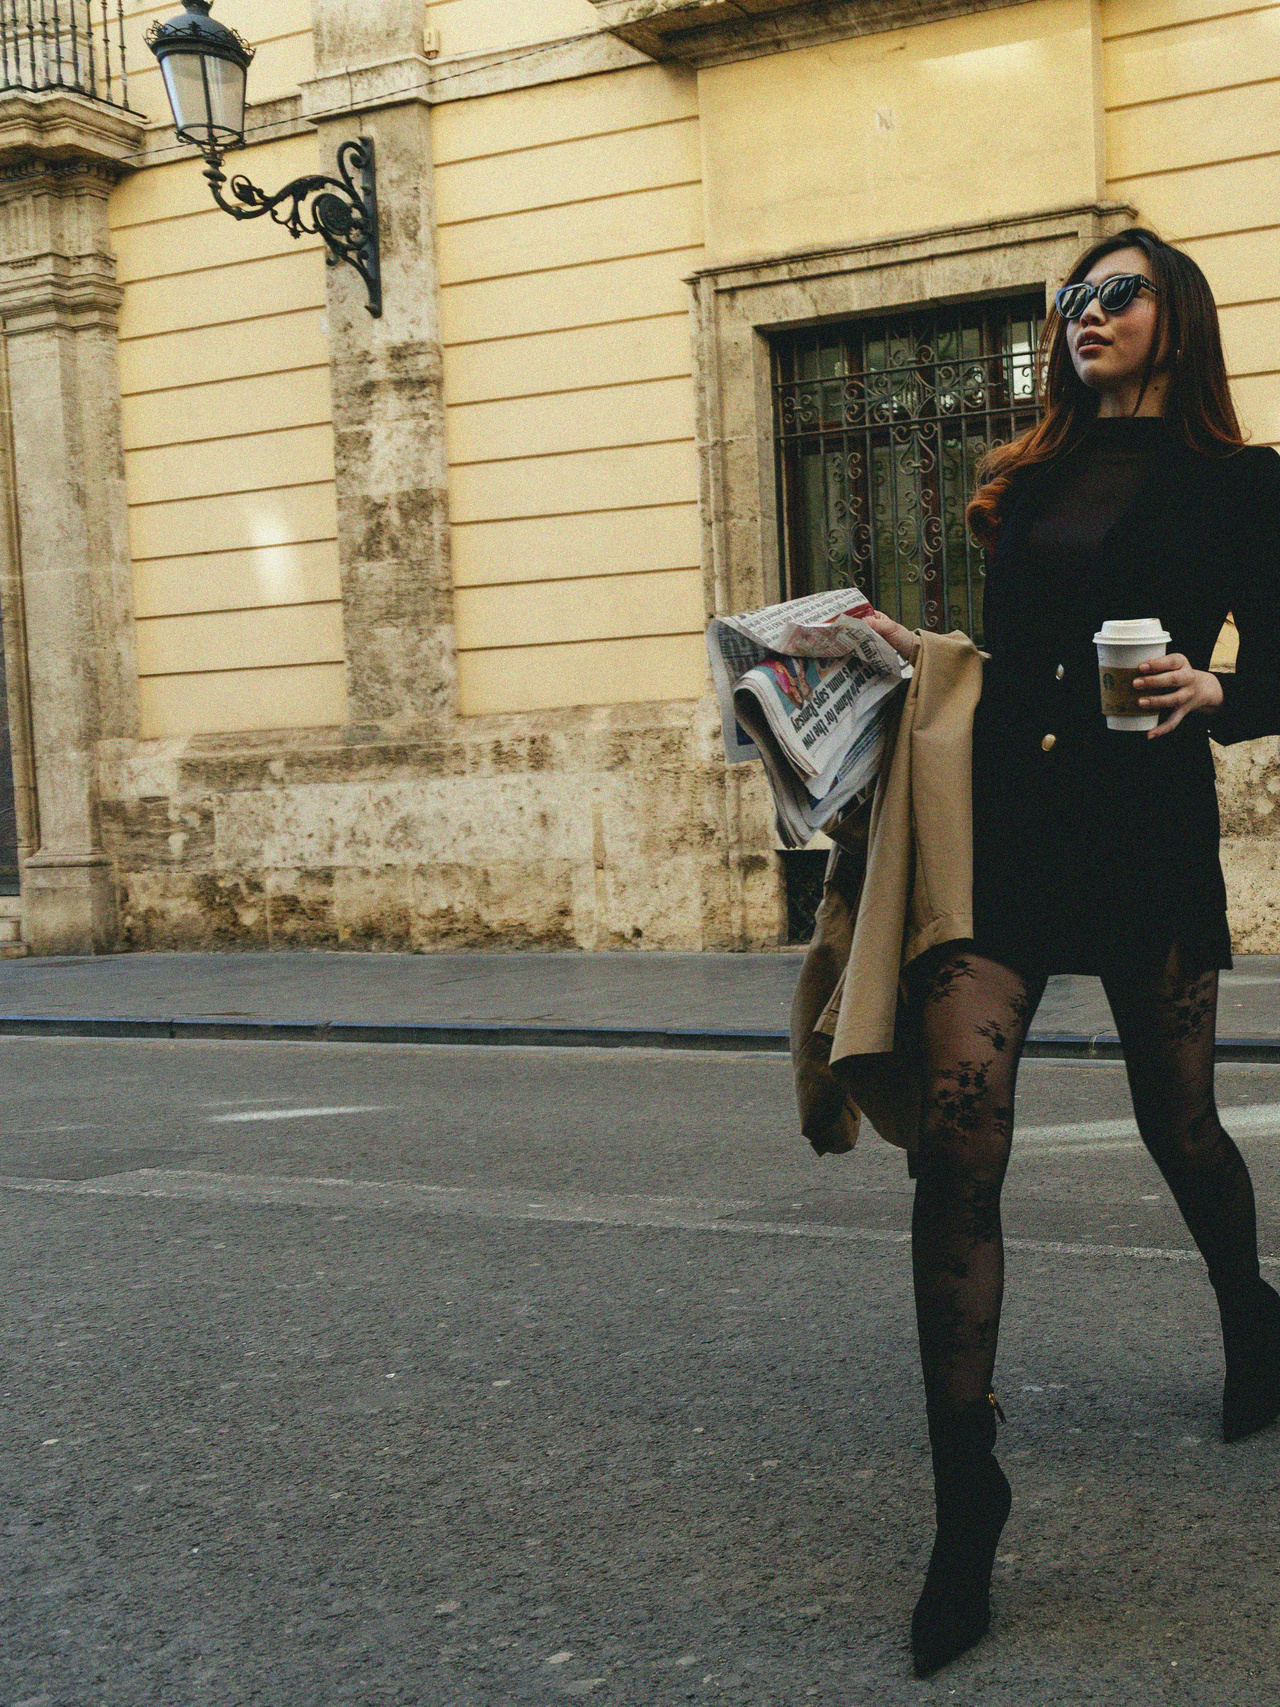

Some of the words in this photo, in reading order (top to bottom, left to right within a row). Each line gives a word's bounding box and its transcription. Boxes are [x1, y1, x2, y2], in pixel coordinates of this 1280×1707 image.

[824, 671, 846, 694] mum,
[813, 686, 829, 709] says
[832, 688, 854, 712] blame
[790, 700, 819, 733] Ramsay
[812, 718, 829, 736] the
[823, 707, 838, 726] for
[801, 729, 816, 750] row
